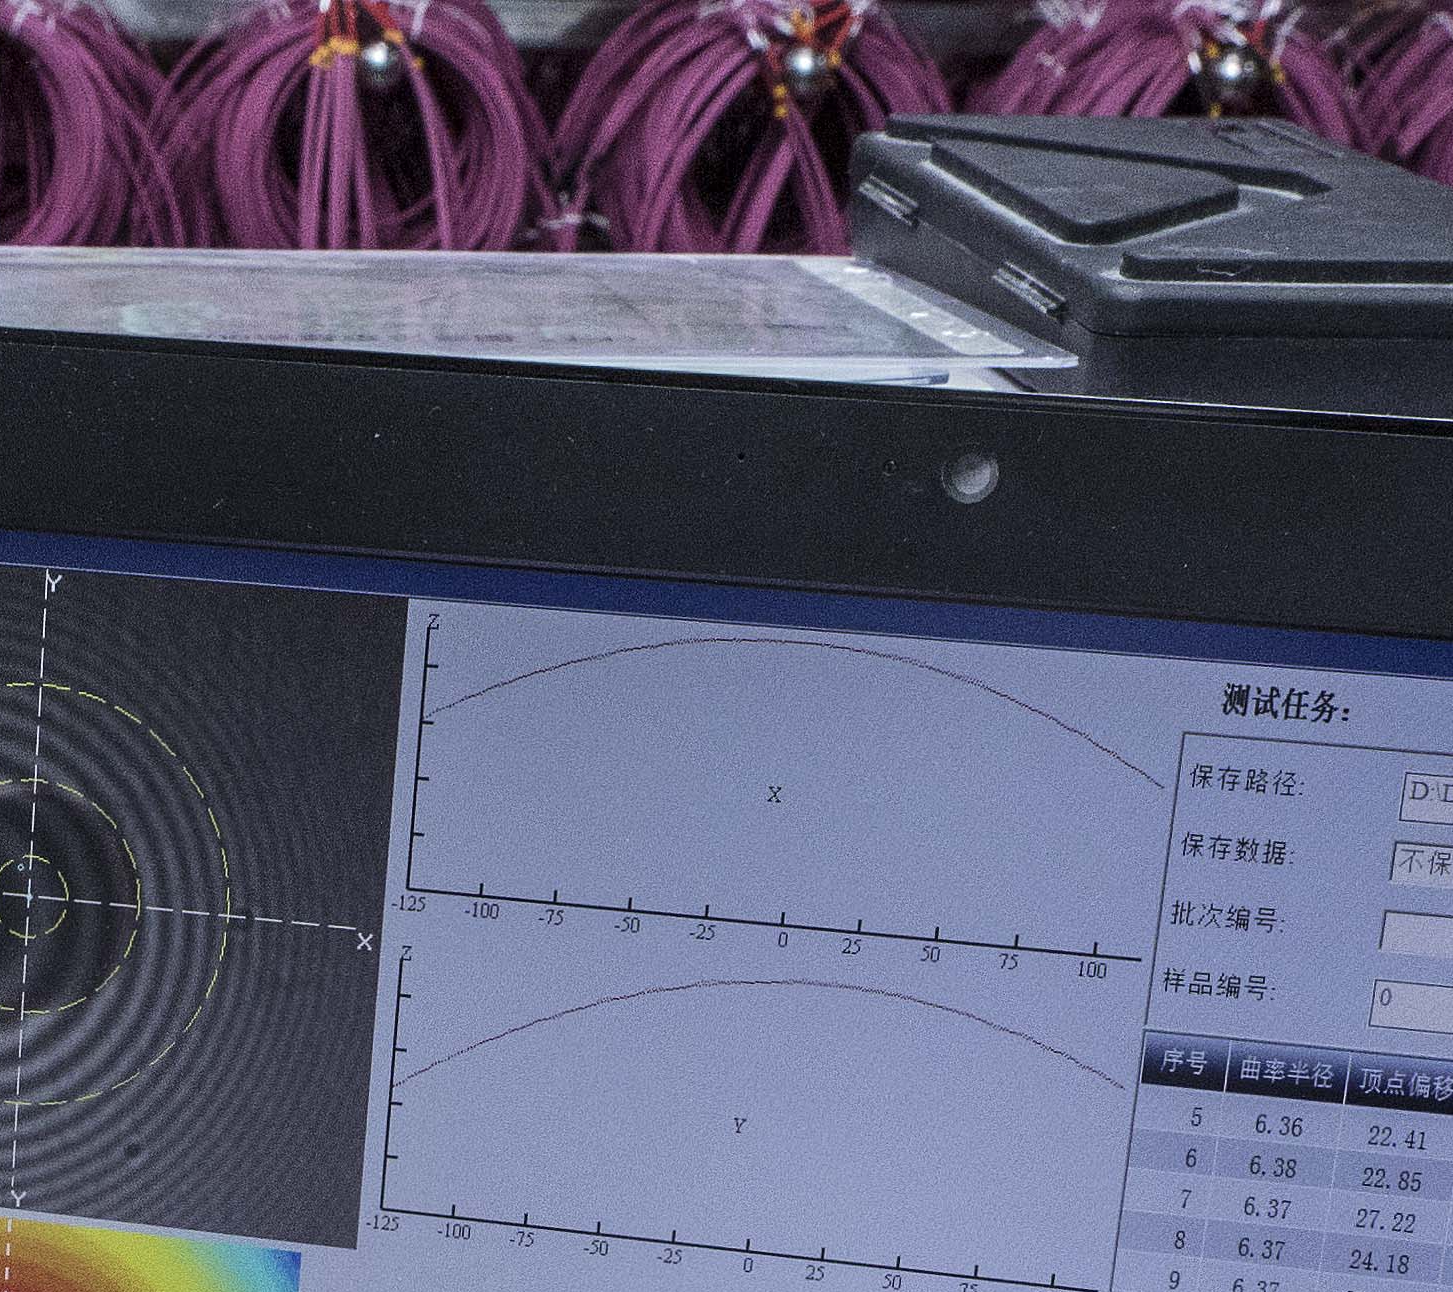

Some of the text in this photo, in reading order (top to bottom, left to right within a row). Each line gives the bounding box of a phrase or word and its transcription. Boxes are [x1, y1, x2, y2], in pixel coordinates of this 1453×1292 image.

[1190, 764, 1305, 796] 保存路径:
[1380, 989, 1392, 1007] 0
[1160, 1050, 1207, 1075] 序号
[1239, 1059, 1334, 1089] 曲率半径
[1190, 1106, 1202, 1127] 5
[1256, 1114, 1303, 1137] 6.36
[1368, 1125, 1425, 1150] 22.41
[1185, 1148, 1197, 1169] 6
[1250, 1155, 1297, 1178] 6.38
[1362, 1167, 1422, 1192] 22.85
[1182, 1189, 1191, 1208] 7
[1244, 1196, 1291, 1219] 6.37
[1355, 1208, 1416, 1233] 27.22
